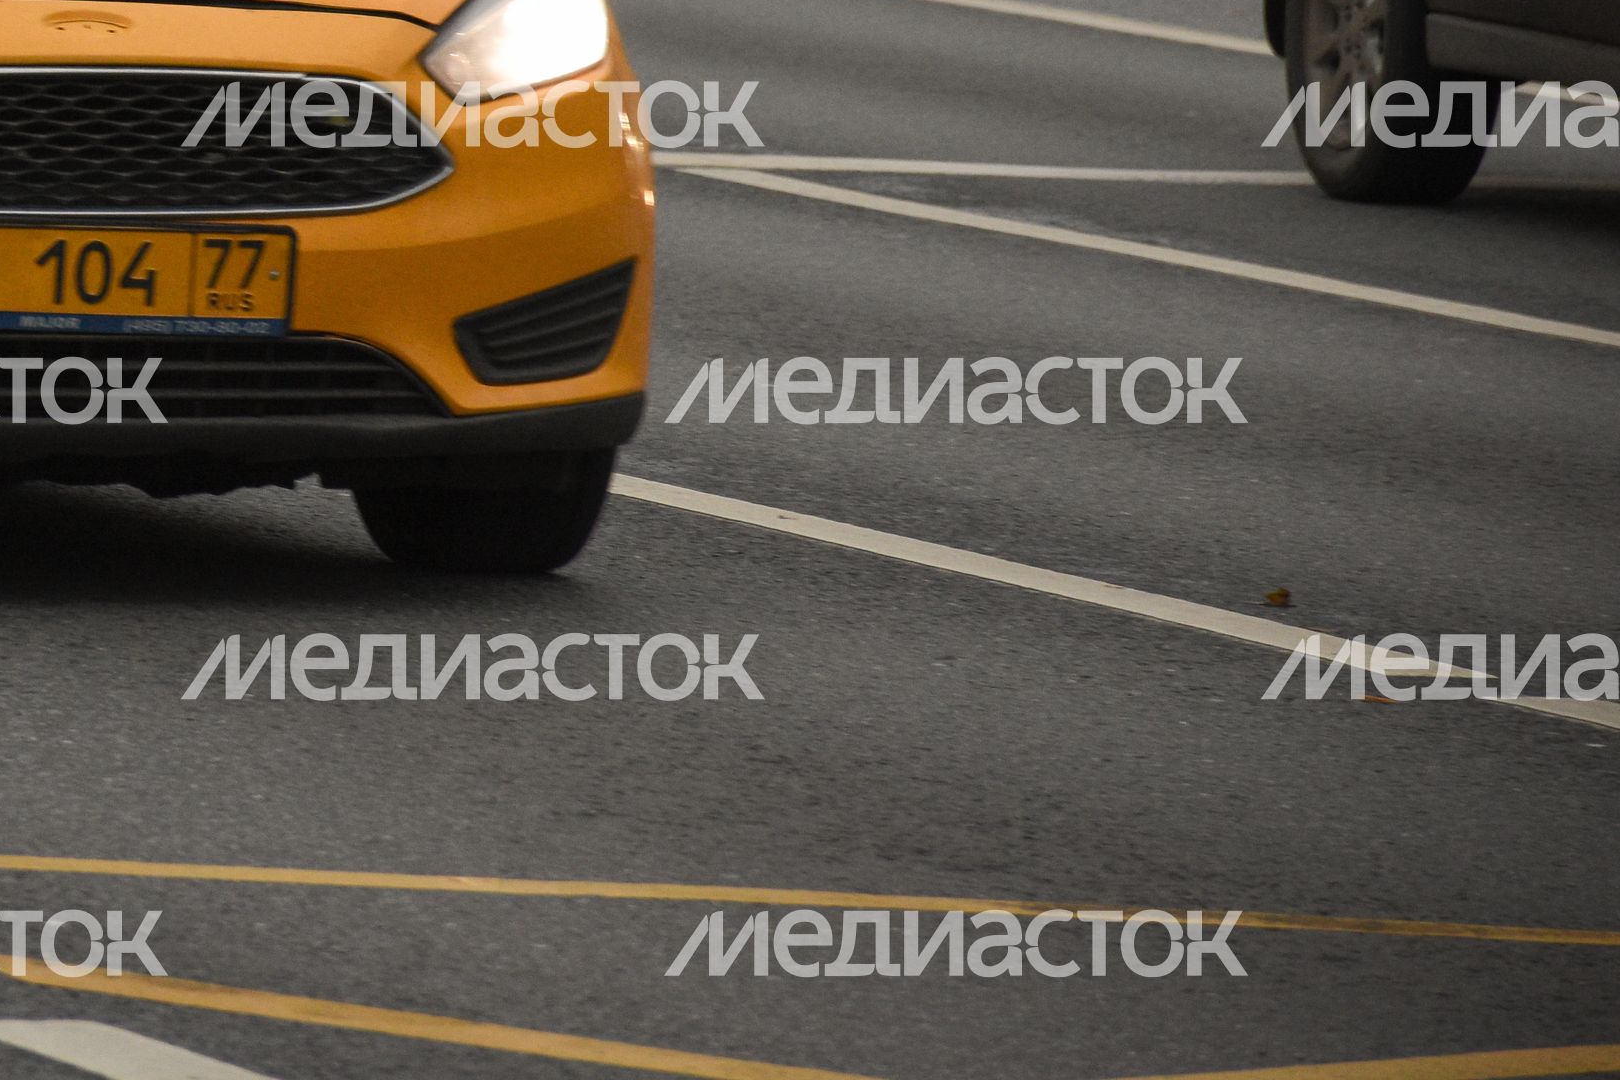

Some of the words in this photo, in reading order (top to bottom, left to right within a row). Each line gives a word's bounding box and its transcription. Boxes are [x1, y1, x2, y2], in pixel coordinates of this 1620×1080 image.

[35, 238, 157, 307] 104
[202, 238, 267, 289] 77
[208, 291, 255, 312] RUS
